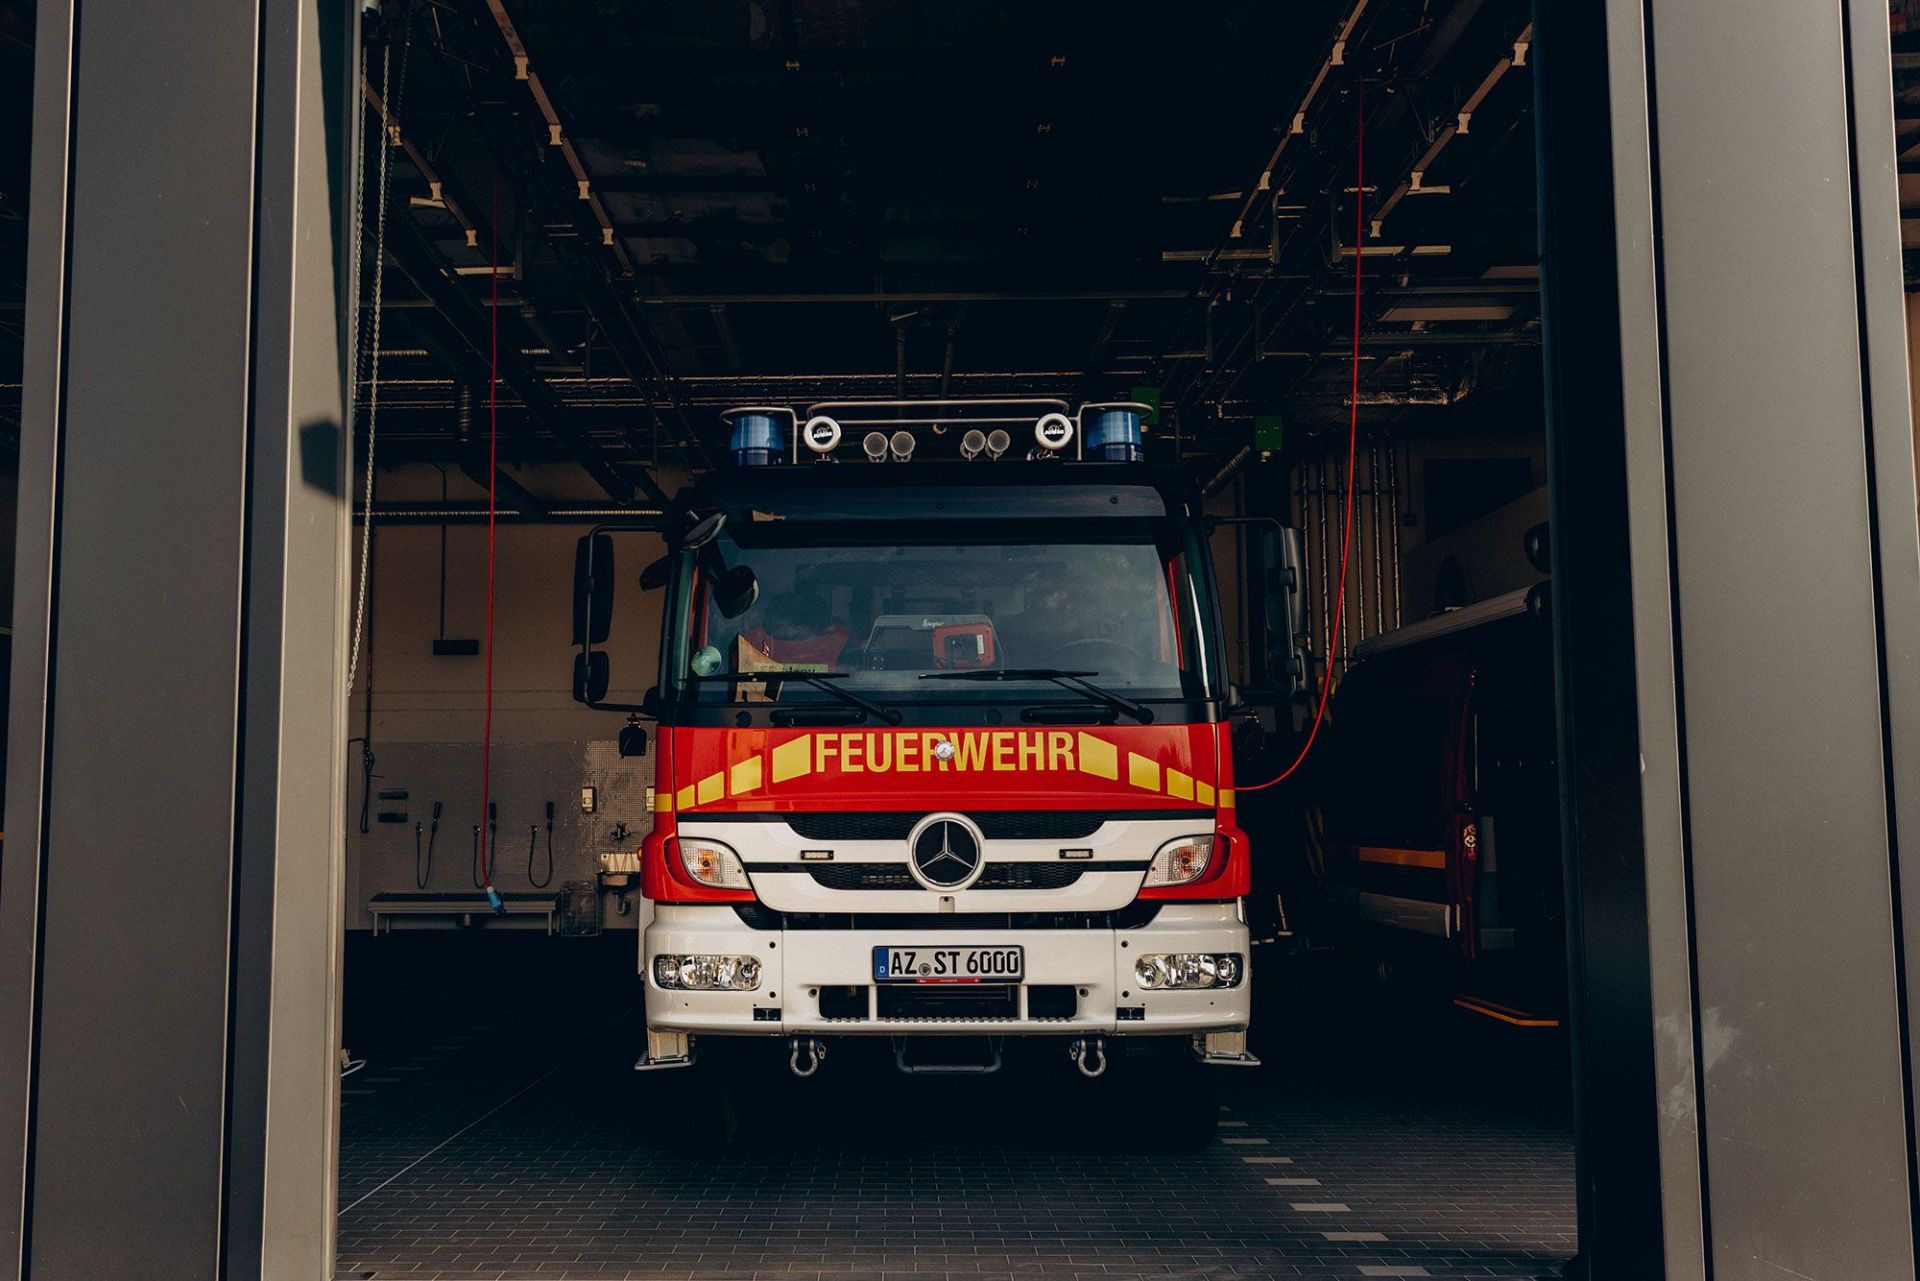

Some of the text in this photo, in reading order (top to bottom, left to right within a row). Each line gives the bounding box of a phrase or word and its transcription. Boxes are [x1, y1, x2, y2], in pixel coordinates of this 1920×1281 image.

[816, 732, 1076, 772] FEUERWEHR
[879, 965, 886, 973] D
[891, 951, 1018, 974] AZ ST 6000
